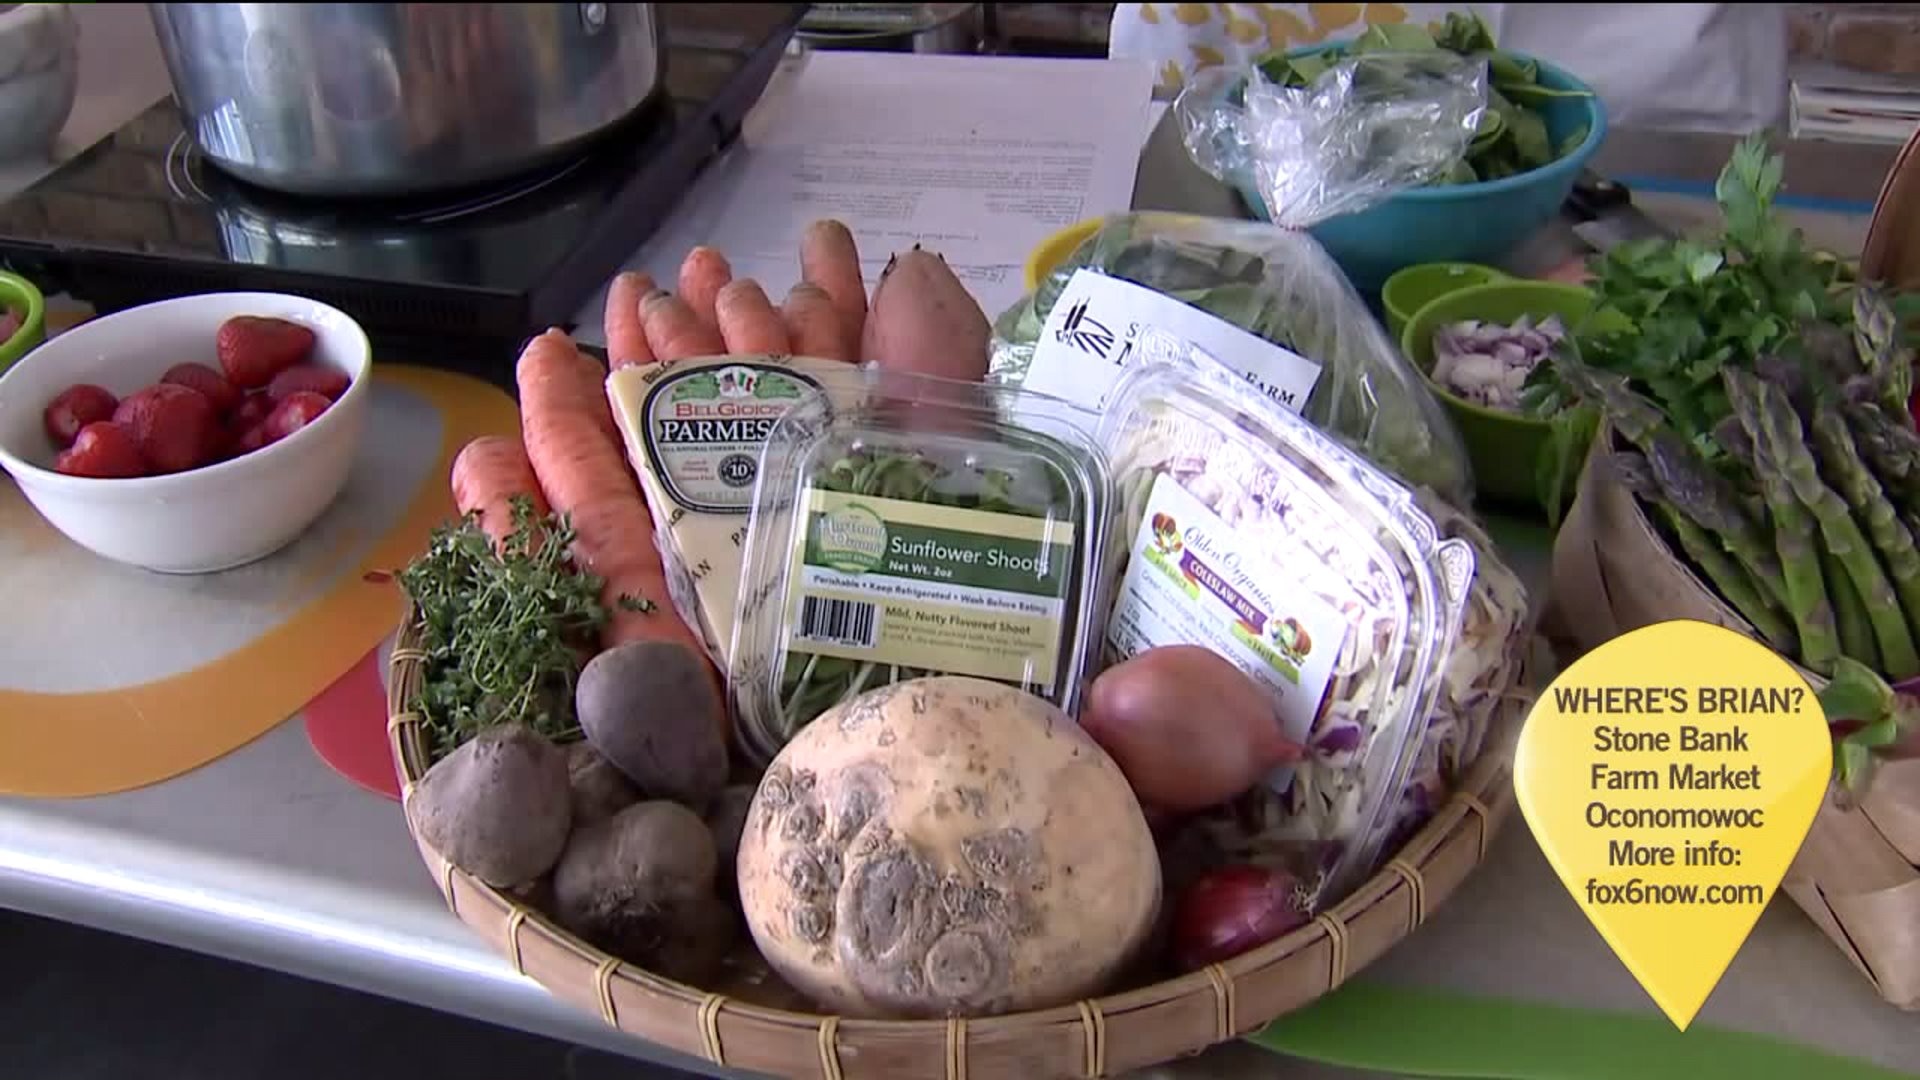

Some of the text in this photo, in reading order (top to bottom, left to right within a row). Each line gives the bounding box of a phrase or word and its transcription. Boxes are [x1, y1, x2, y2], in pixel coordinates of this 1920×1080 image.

[662, 420, 770, 441] PARMES
[730, 464, 748, 477] 10
[891, 535, 982, 564] Sunflower
[889, 560, 953, 578] Net Wt. 2oz
[1190, 560, 1238, 606] COLESLAW
[813, 575, 1048, 615] Perishable Keep Refrigerated Wash Before Eating
[885, 607, 1031, 635] Mild, Nutty Flavored Shoot
